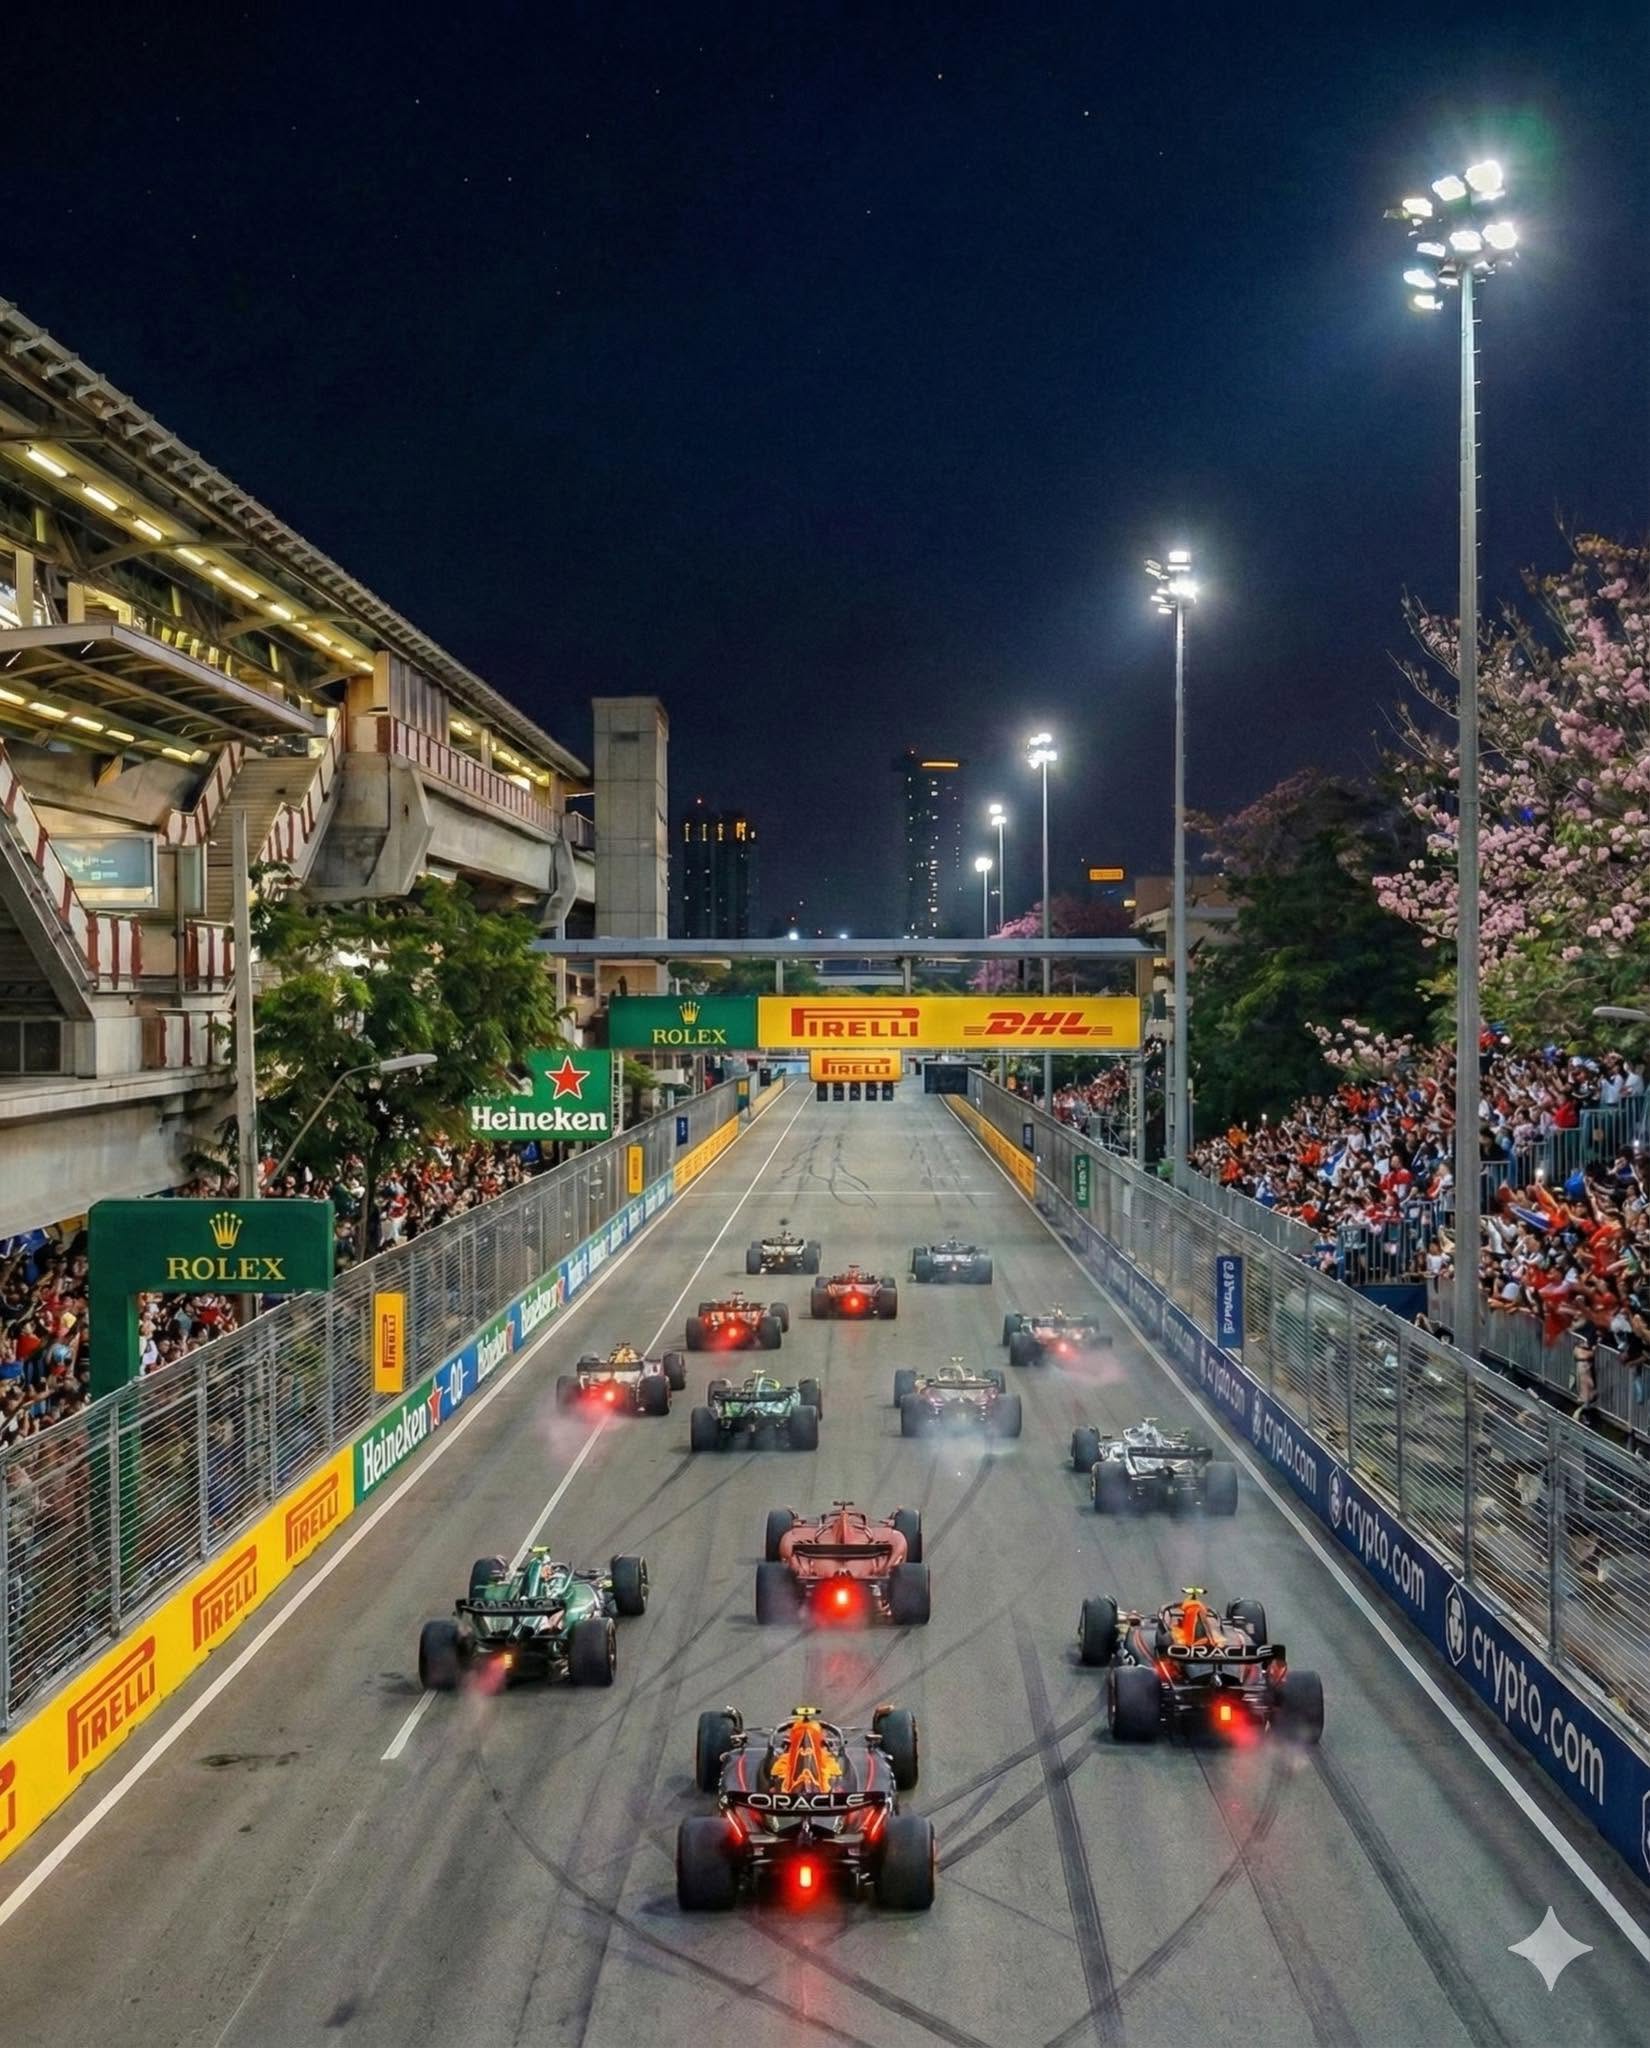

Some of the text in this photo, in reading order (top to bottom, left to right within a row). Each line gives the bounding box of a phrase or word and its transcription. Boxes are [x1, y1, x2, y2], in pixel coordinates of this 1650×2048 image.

[791, 1007, 920, 1037] PIRELLI
[984, 1012, 1092, 1036] DHL
[652, 1029, 727, 1045] ROLEX
[821, 1058, 891, 1075] PIRELLI
[471, 1105, 608, 1131] Heineken
[166, 1257, 286, 1281] ROLEX
[361, 1402, 428, 1491] Heineken
[285, 1471, 339, 1562] PIRELLI
[1345, 1495, 1426, 1612] crypto.com
[192, 1543, 258, 1652] PIRELLI
[1167, 1644, 1276, 1658] ORACLE
[67, 1634, 156, 1775] PIRELLI
[1471, 1625, 1604, 1806] crypto.com
[747, 1793, 866, 1810] ORACLE
